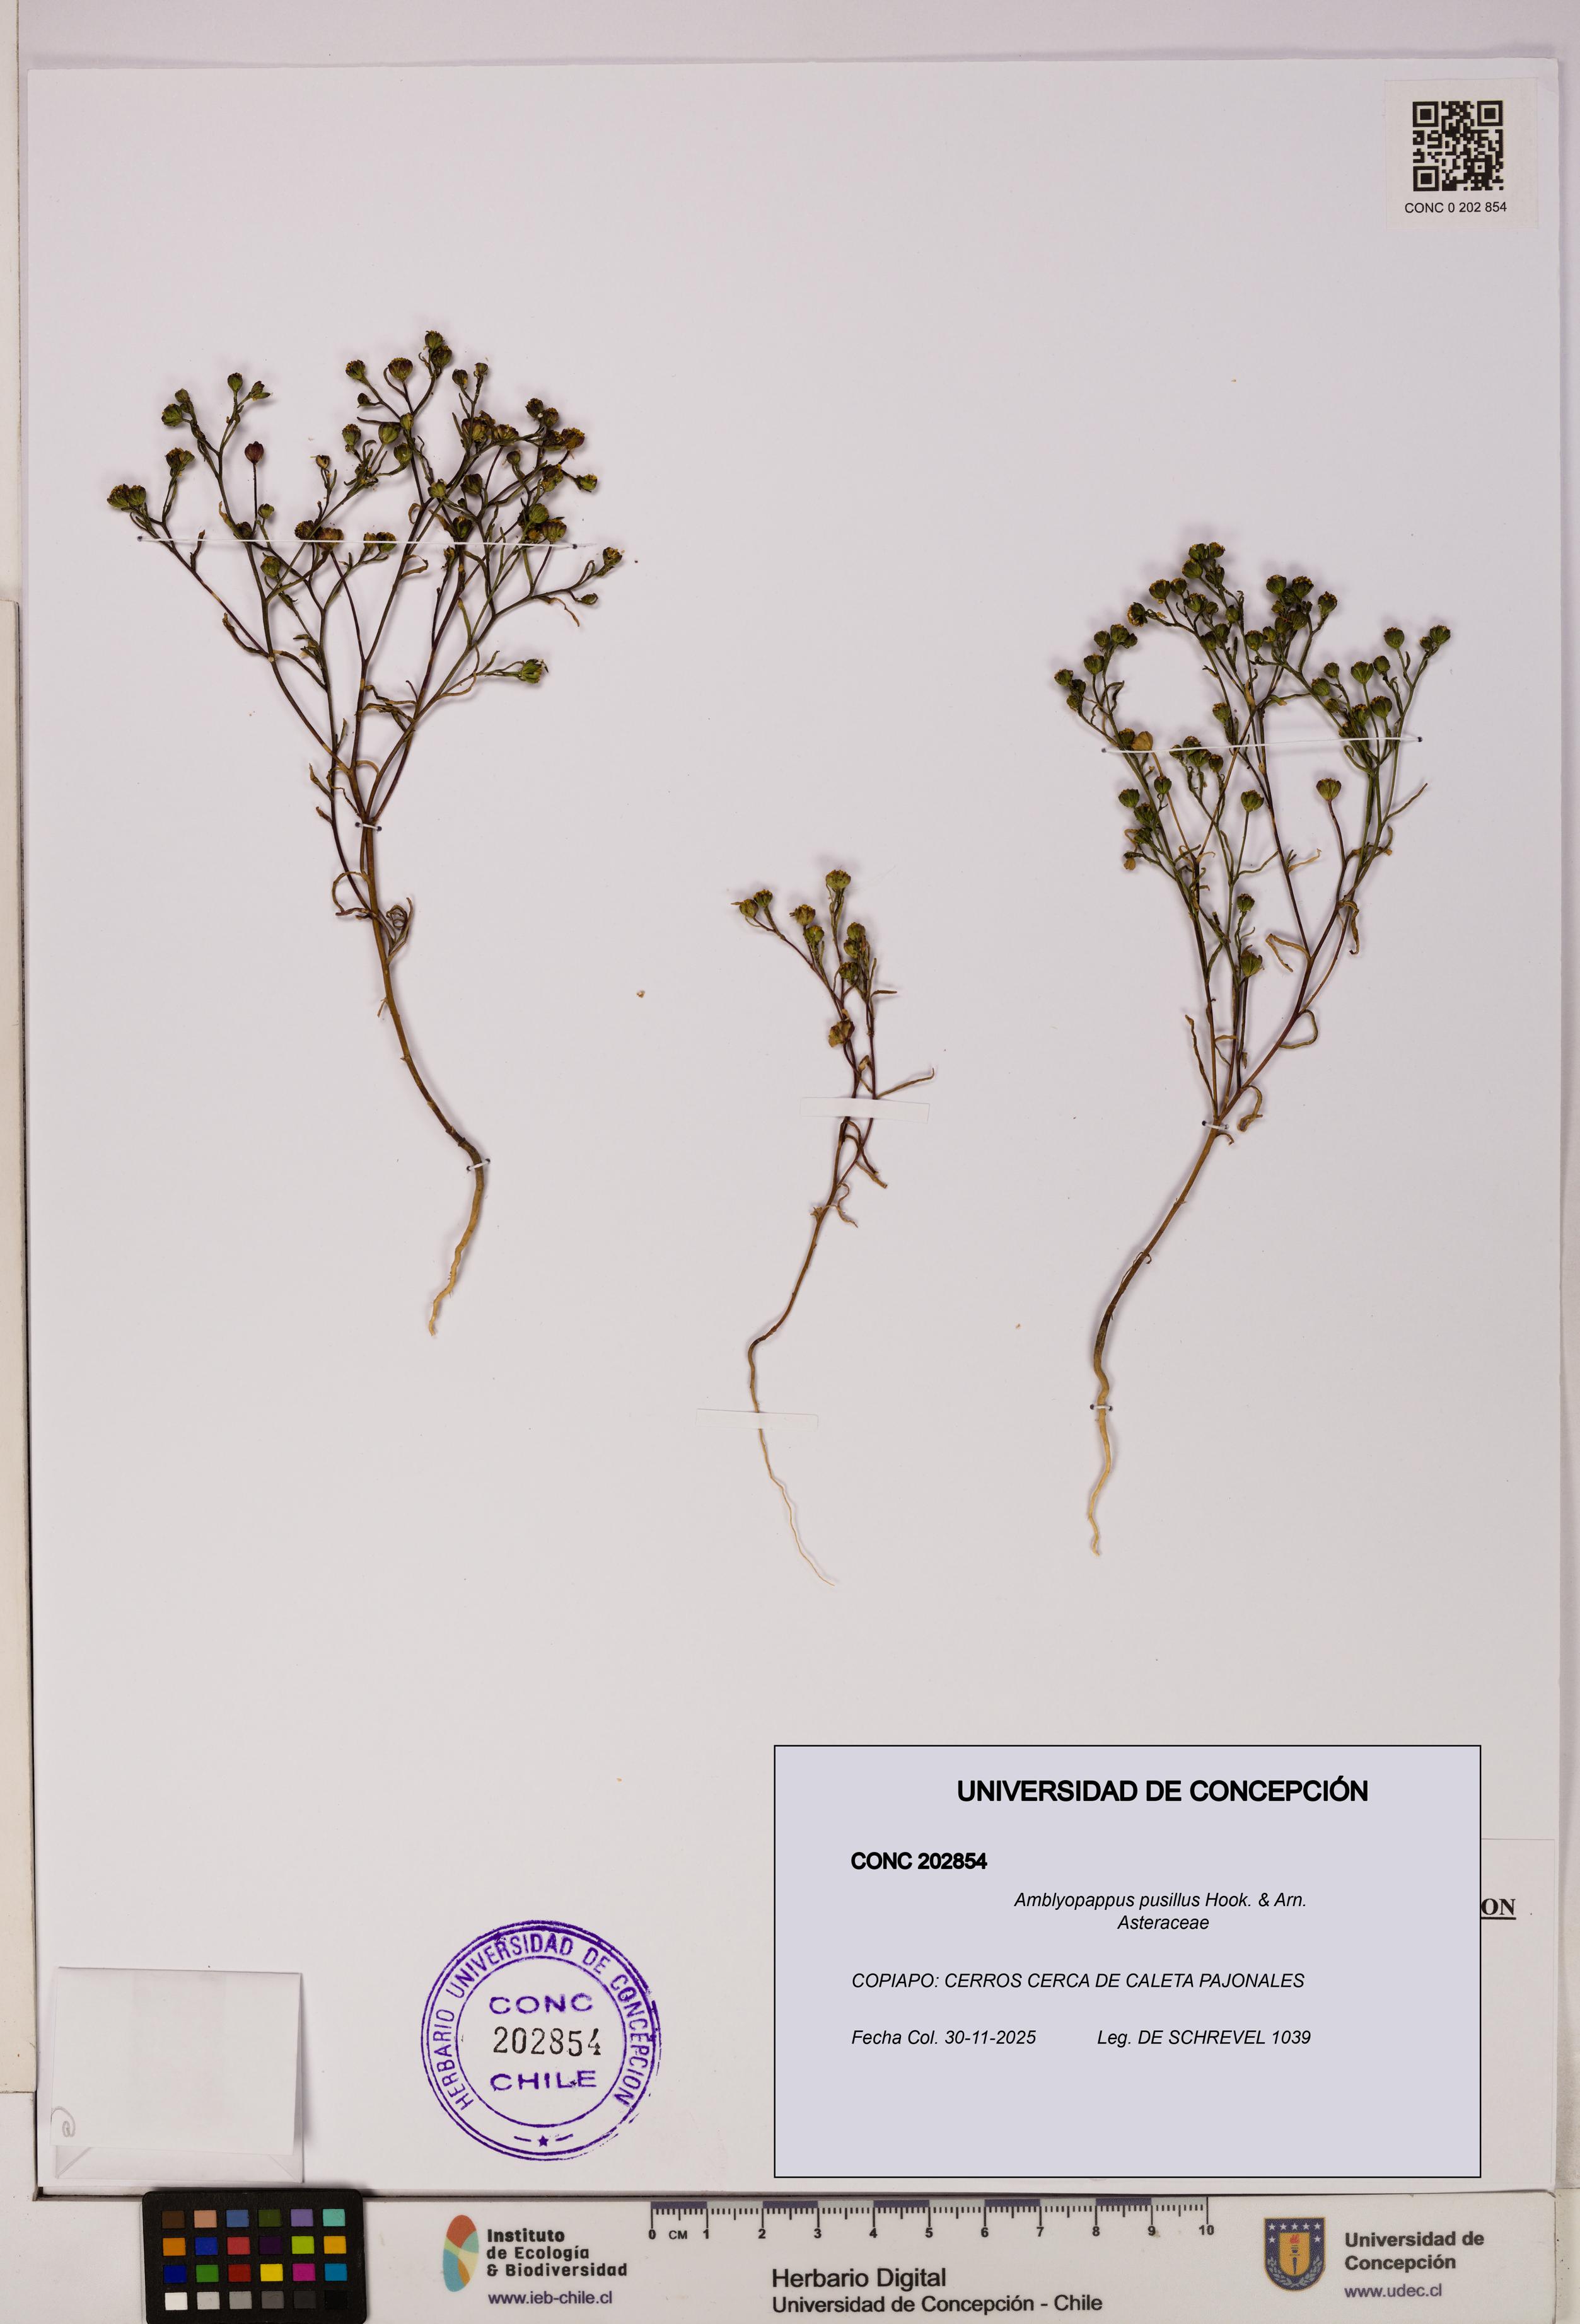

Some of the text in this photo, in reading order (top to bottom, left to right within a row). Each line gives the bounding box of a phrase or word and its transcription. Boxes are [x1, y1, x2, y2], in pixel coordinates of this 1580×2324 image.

[1405, 202, 1507, 213] CONC 0 202 854
[489, 1993, 593, 2014] CONC
[433, 1933, 650, 2110] HERBARIO UNIVERSIDAD DE CONCEPCION
[493, 2026, 601, 2056] 202854
[490, 2071, 596, 2091] CHILE
[487, 2228, 566, 2243] Instituto
[649, 2224, 1214, 2240] 0 CM 1 2 3 4 5 6 7 8 9 10
[1345, 2231, 1485, 2248] Universidad de
[486, 2245, 590, 2262] de Ecología
[487, 2262, 627, 2277] & Biodiversidad
[1344, 2253, 1456, 2274] Concepción
[772, 2267, 946, 2291] Herbario Digital
[487, 2290, 612, 2304] www.ieb-chile.cl
[1344, 2282, 1443, 2298] www.udec.cl
[772, 2296, 885, 2313] Universidad
[891, 2296, 915, 2313] de
[921, 2294, 1035, 2316] Concepción
[1054, 2294, 1103, 2311] Chile
